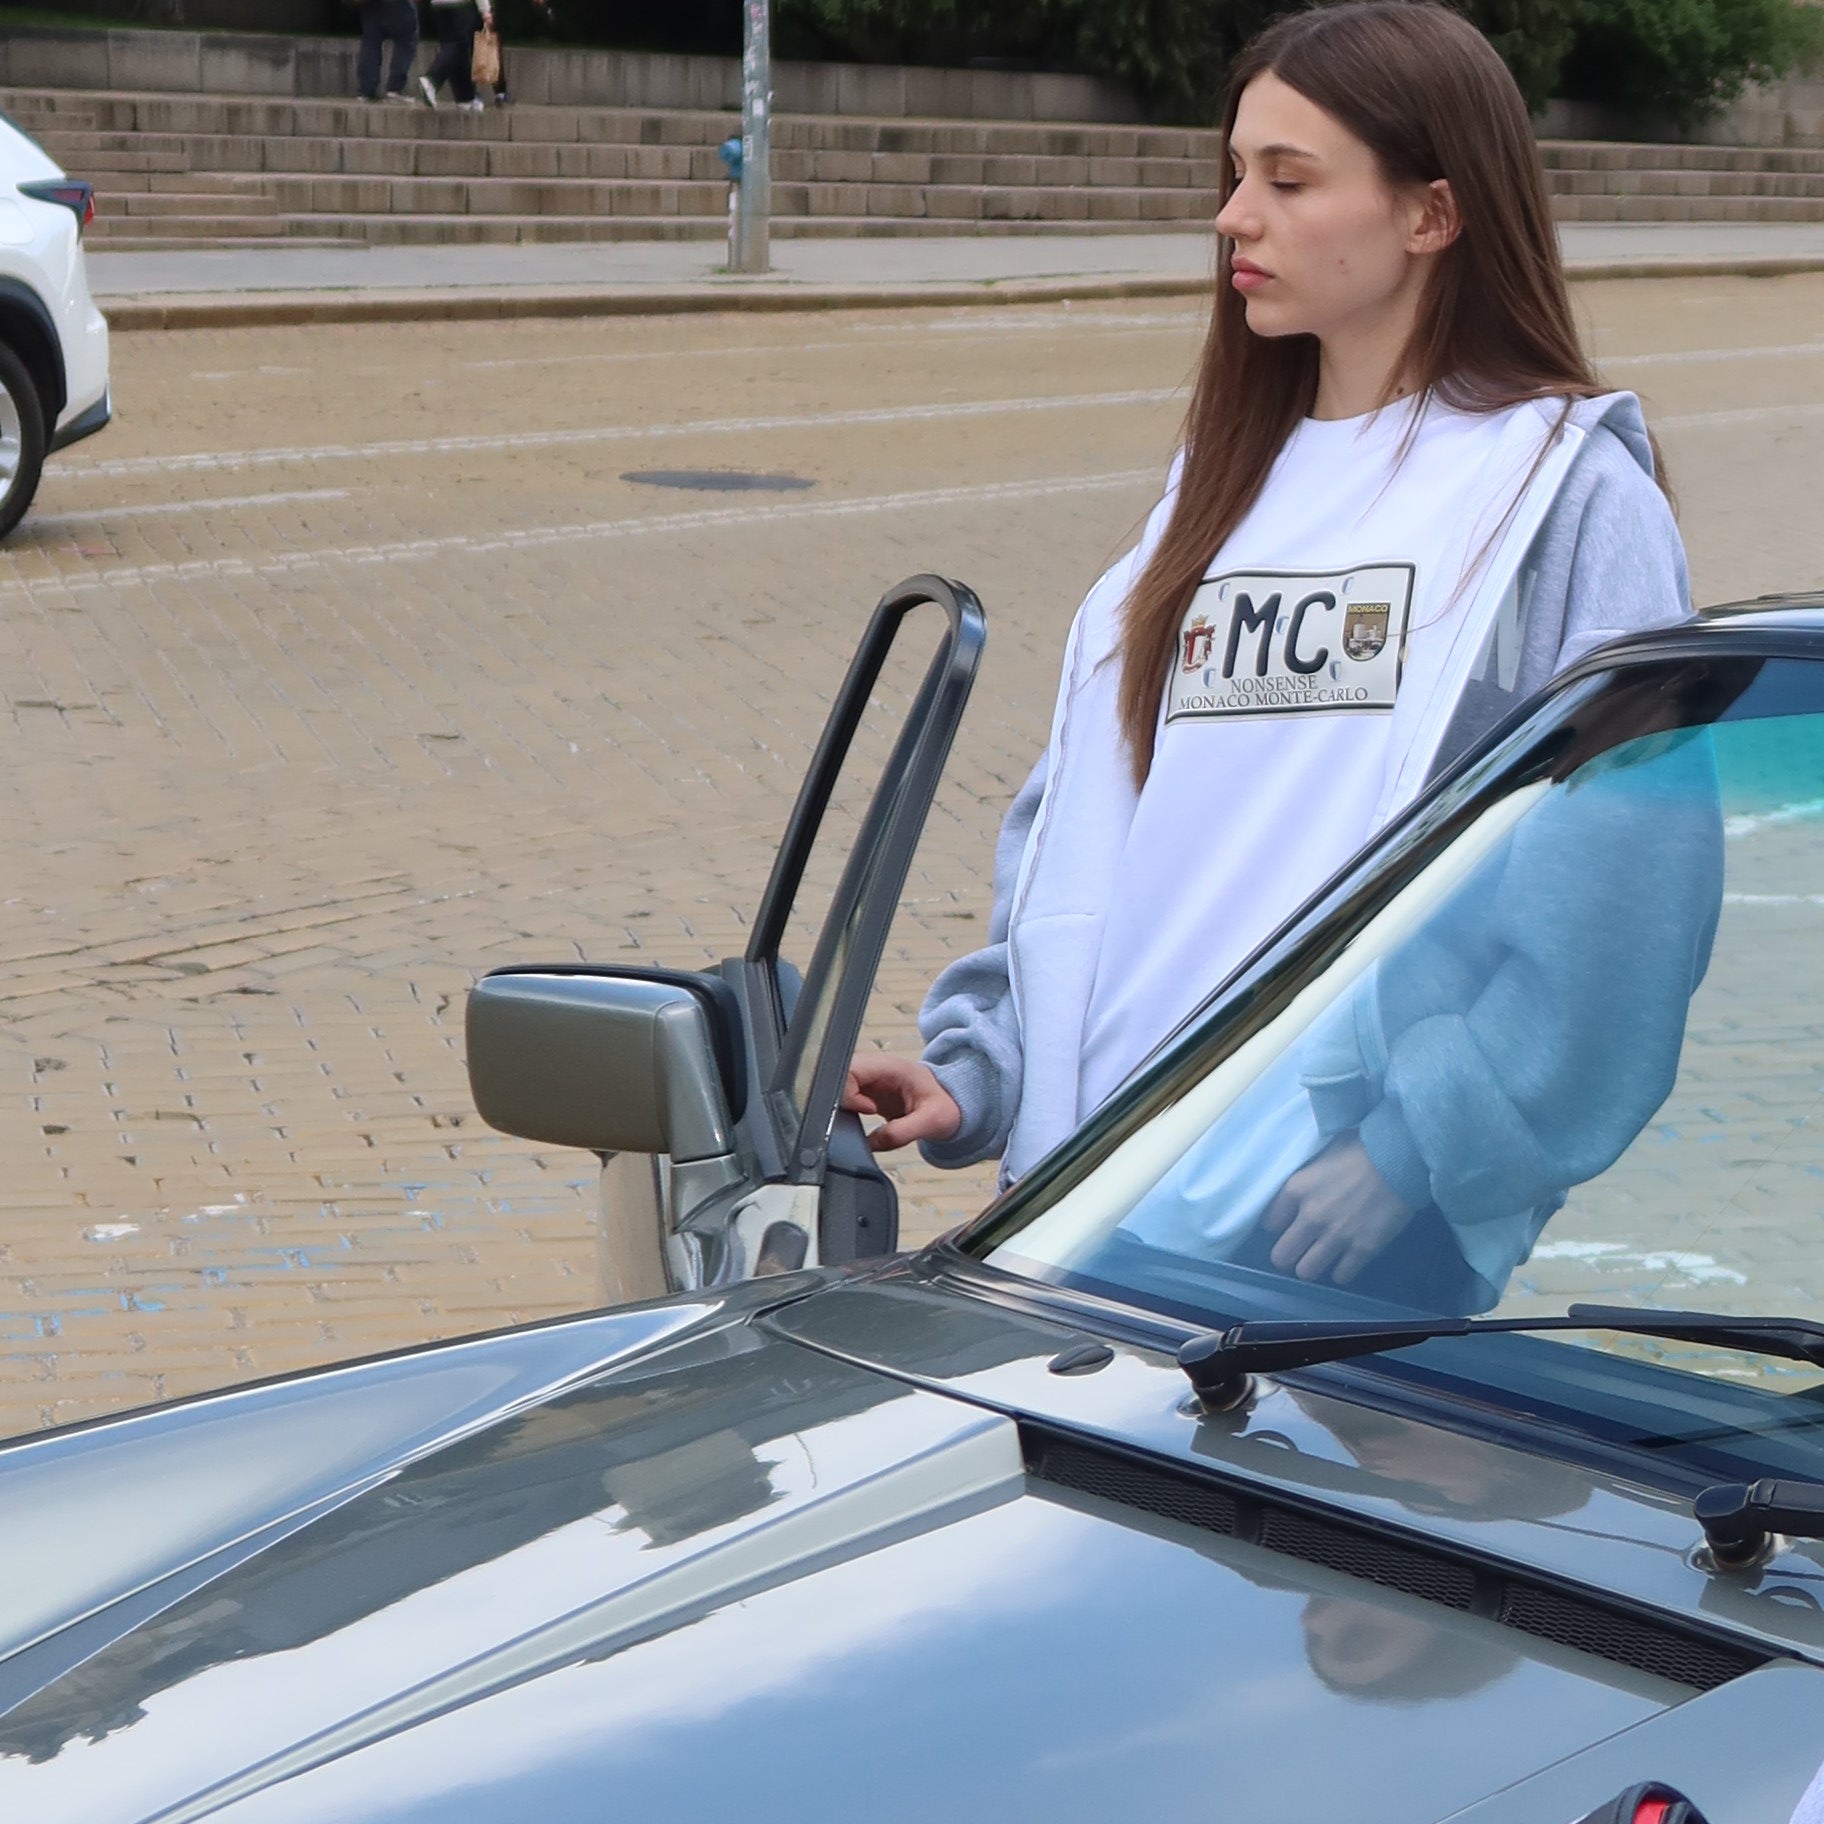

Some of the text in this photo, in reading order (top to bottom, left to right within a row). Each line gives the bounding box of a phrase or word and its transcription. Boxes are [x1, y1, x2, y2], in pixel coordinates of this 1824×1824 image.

[1348, 604, 1388, 614] MONACO
[1222, 590, 1336, 679] MC
[1231, 674, 1318, 693] NONSENSE
[1179, 686, 1368, 709] MONACO MONTE-CARLO
